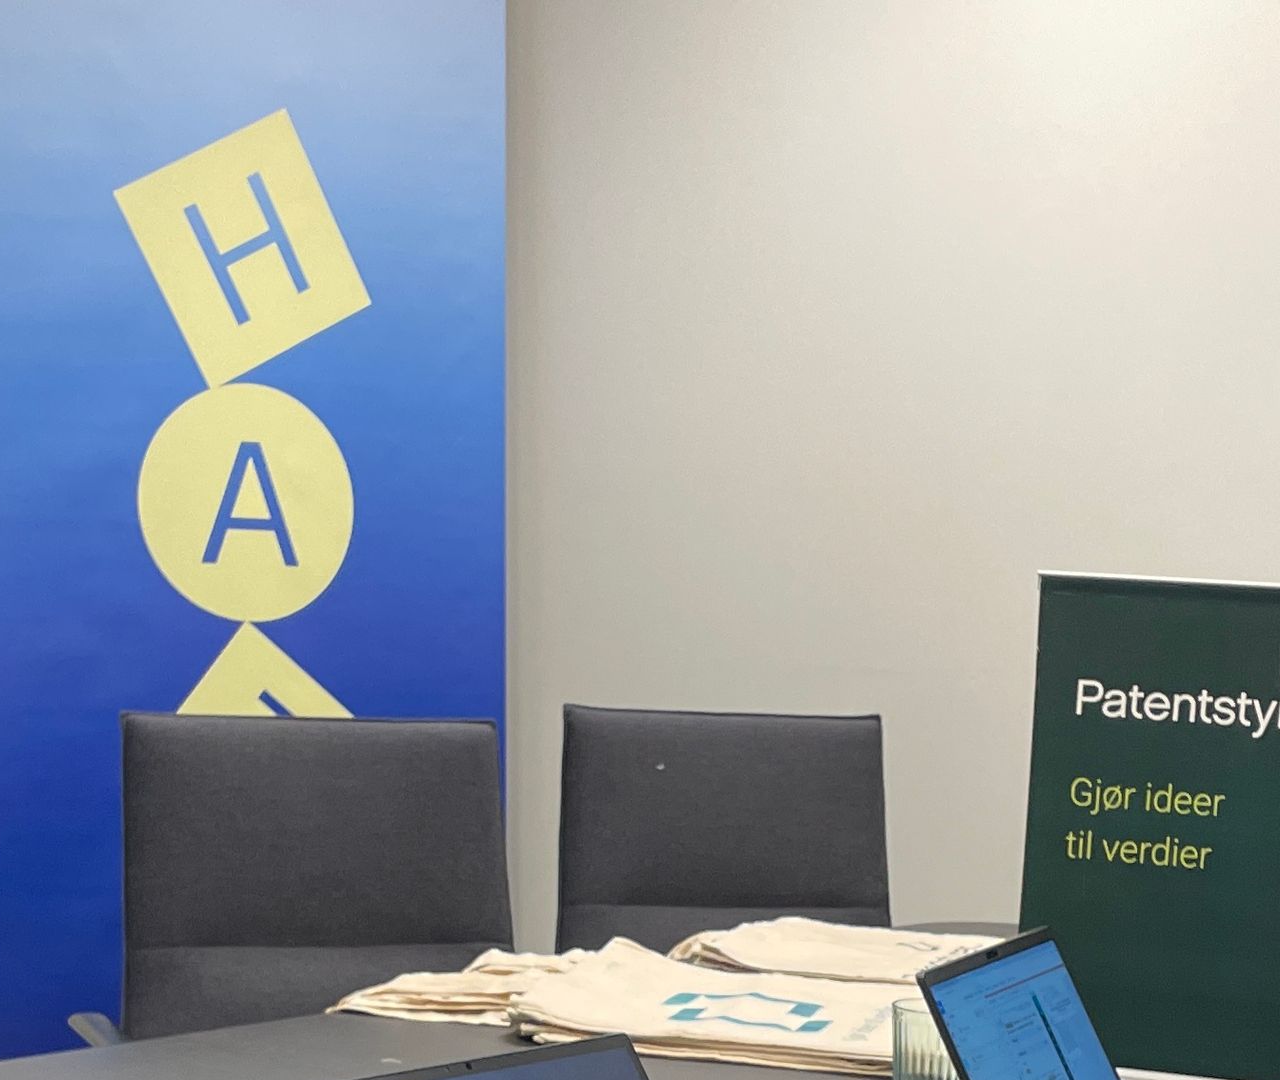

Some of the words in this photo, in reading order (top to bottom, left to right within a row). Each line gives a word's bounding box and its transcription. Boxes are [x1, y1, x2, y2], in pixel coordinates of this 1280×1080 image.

[183, 171, 312, 326] H
[201, 440, 300, 567] A
[1070, 776, 1136, 815] Gjør
[1145, 781, 1226, 817] ideer
[1065, 829, 1093, 861] til
[1103, 835, 1214, 870] verdier
